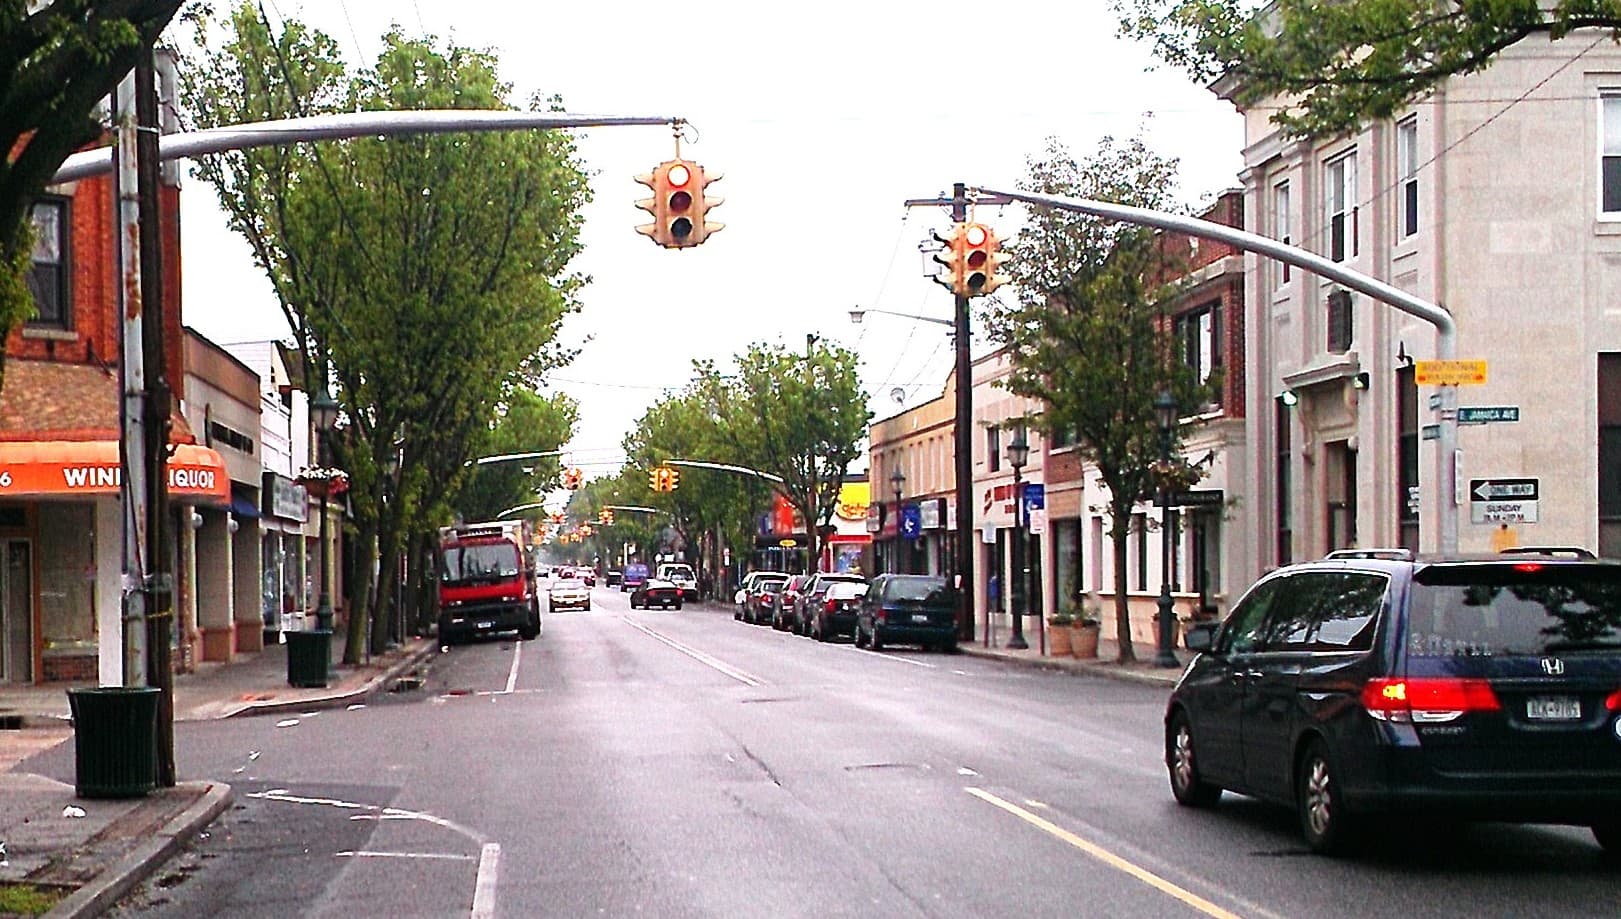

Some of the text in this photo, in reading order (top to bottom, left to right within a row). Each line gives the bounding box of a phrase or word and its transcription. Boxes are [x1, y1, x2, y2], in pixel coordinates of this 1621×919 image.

[167, 468, 215, 489] IQUOR
[1490, 485, 1532, 495] ONE WAY
[1486, 504, 1521, 512] SUNDAY
